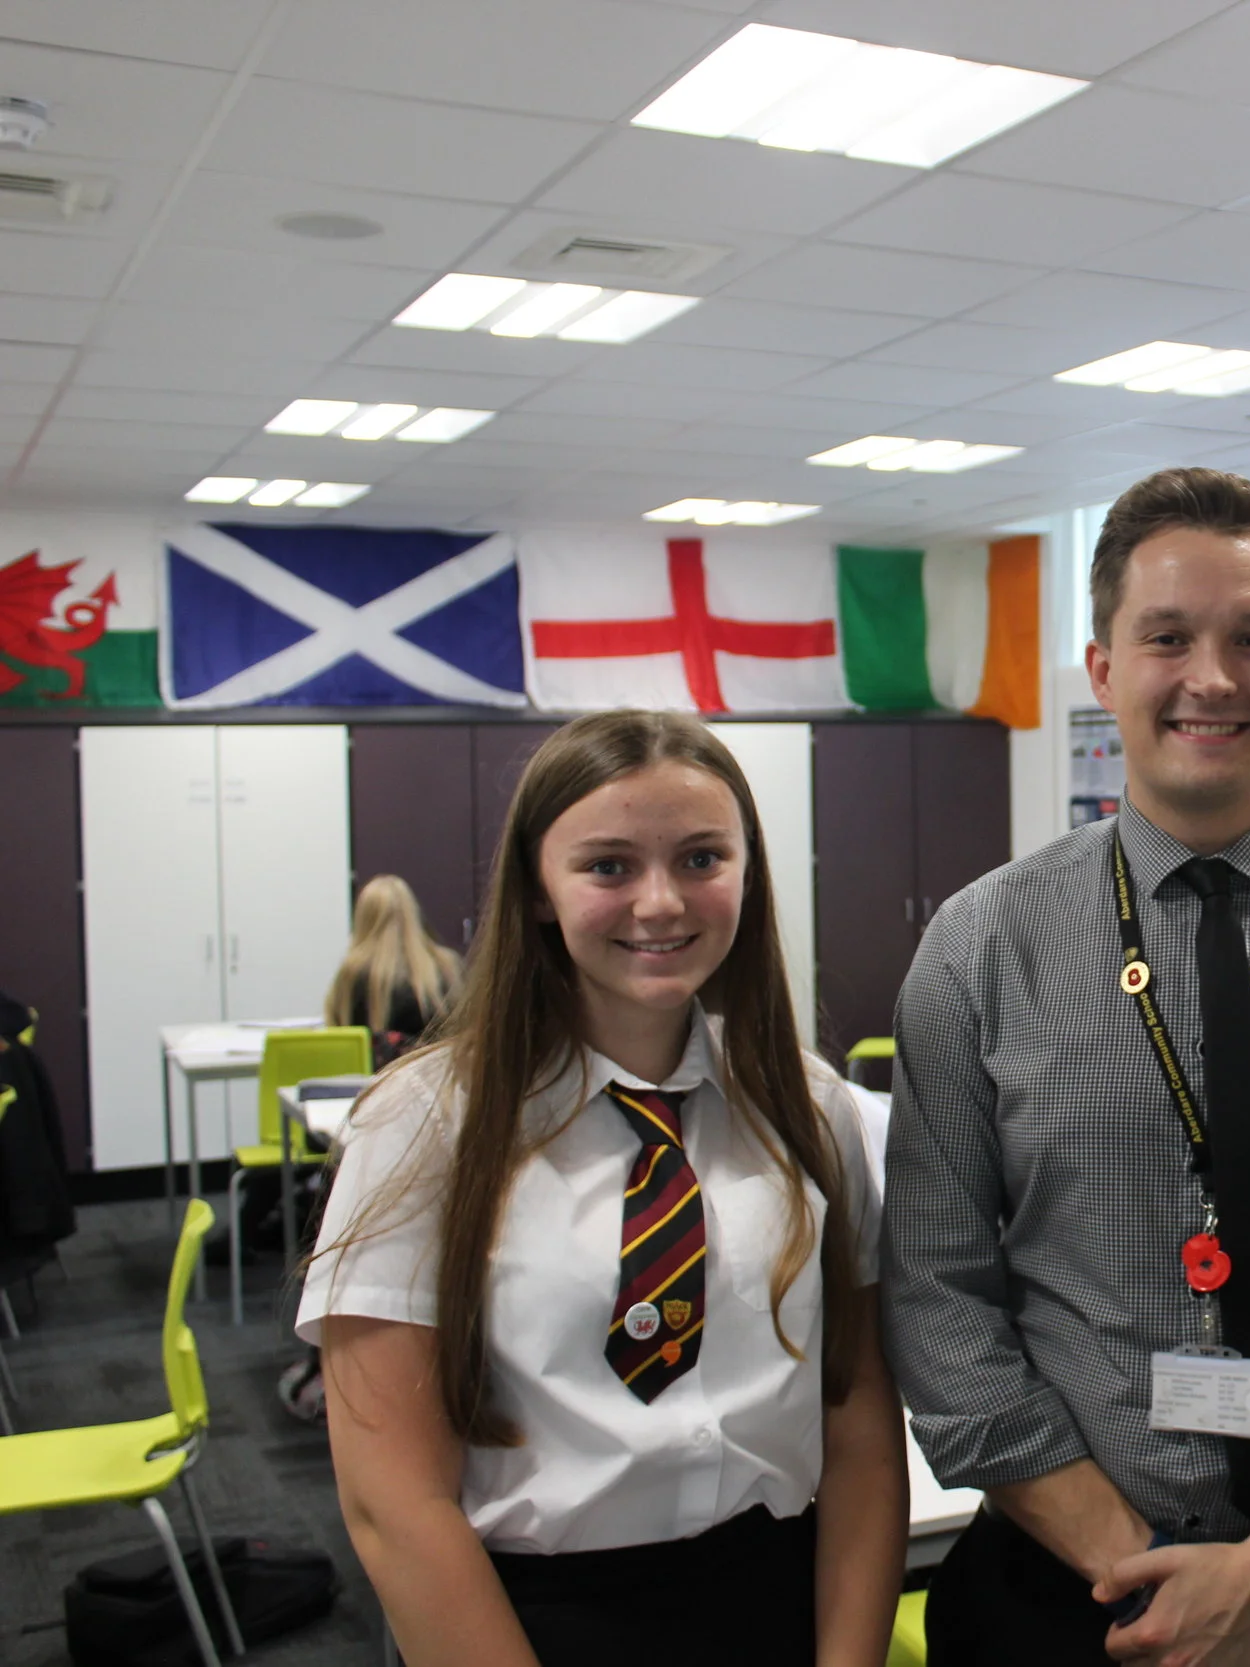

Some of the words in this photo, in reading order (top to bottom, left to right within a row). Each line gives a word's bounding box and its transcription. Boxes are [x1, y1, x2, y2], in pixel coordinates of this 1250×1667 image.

[1139, 991, 1158, 1027] Schoo
[1152, 1026, 1183, 1090] Community
[1177, 1089, 1204, 1144] Aberdare
